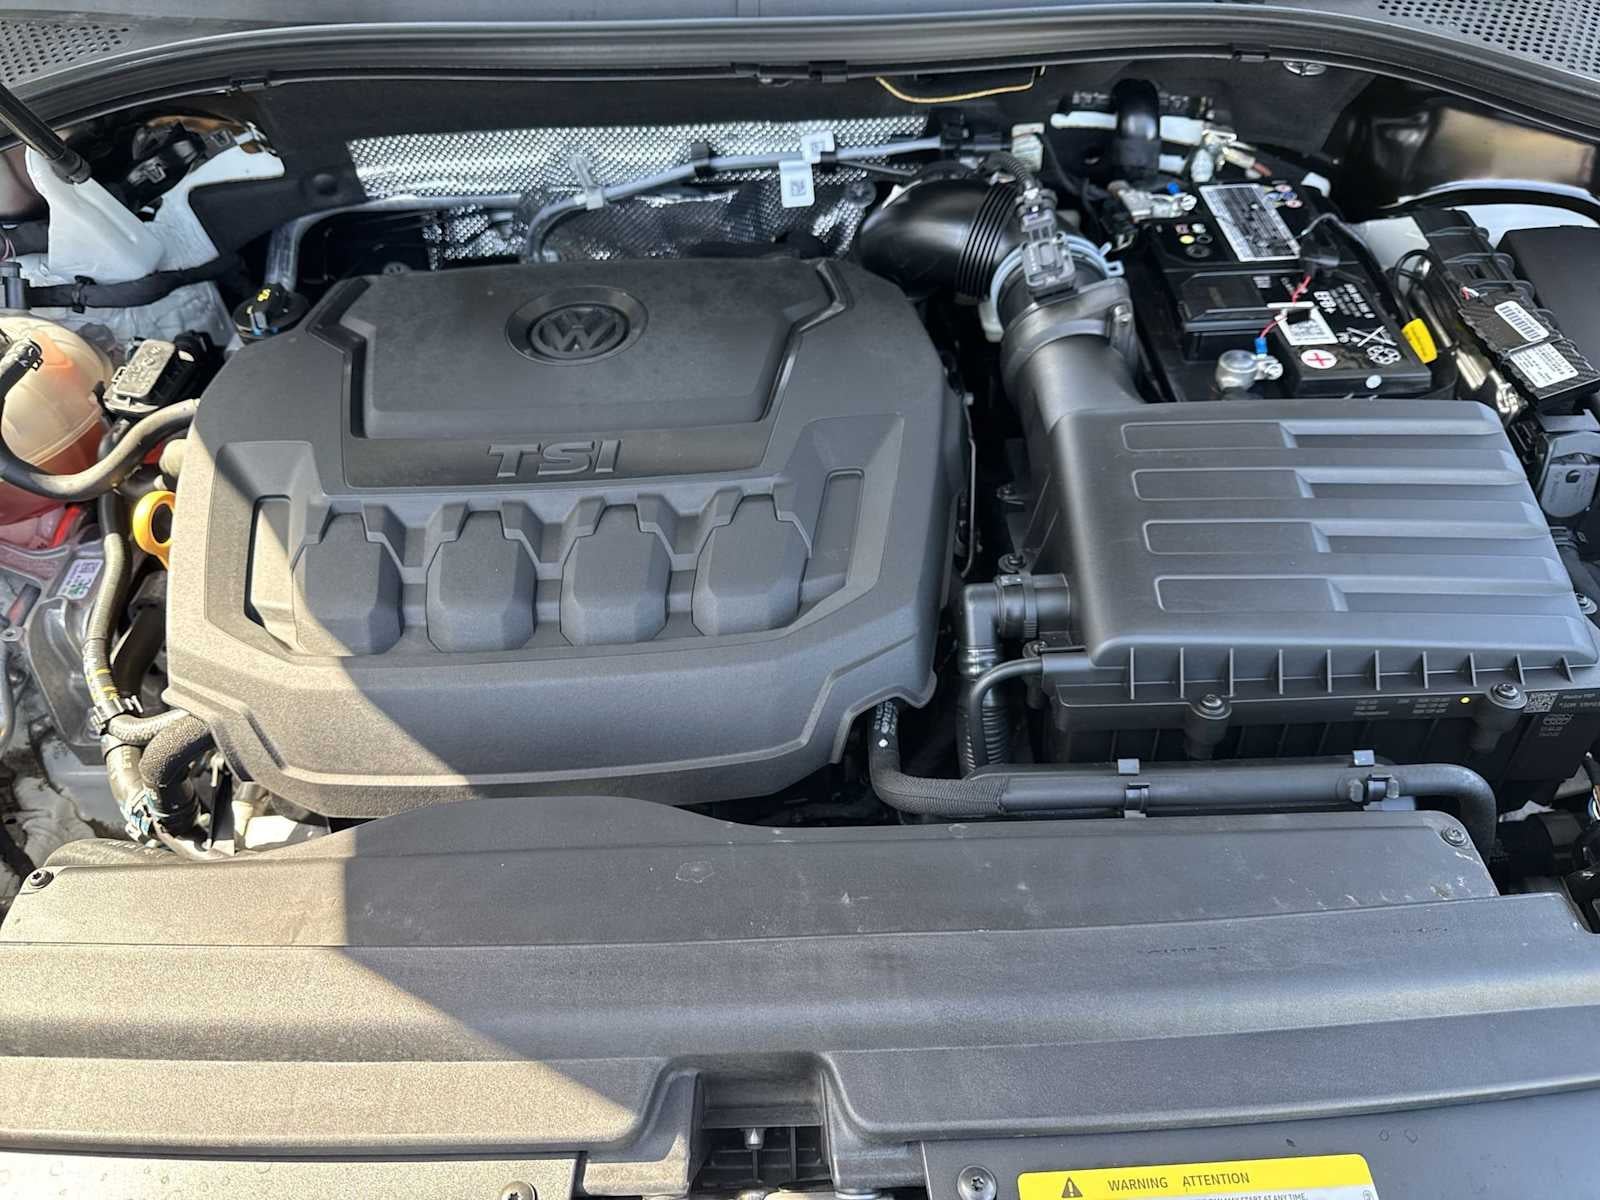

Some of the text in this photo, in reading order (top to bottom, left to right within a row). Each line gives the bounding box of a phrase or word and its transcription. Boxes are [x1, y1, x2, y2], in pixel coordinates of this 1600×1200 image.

[488, 439, 623, 478] TSI
[1107, 1172, 1250, 1192] WARNING ATTENTION
